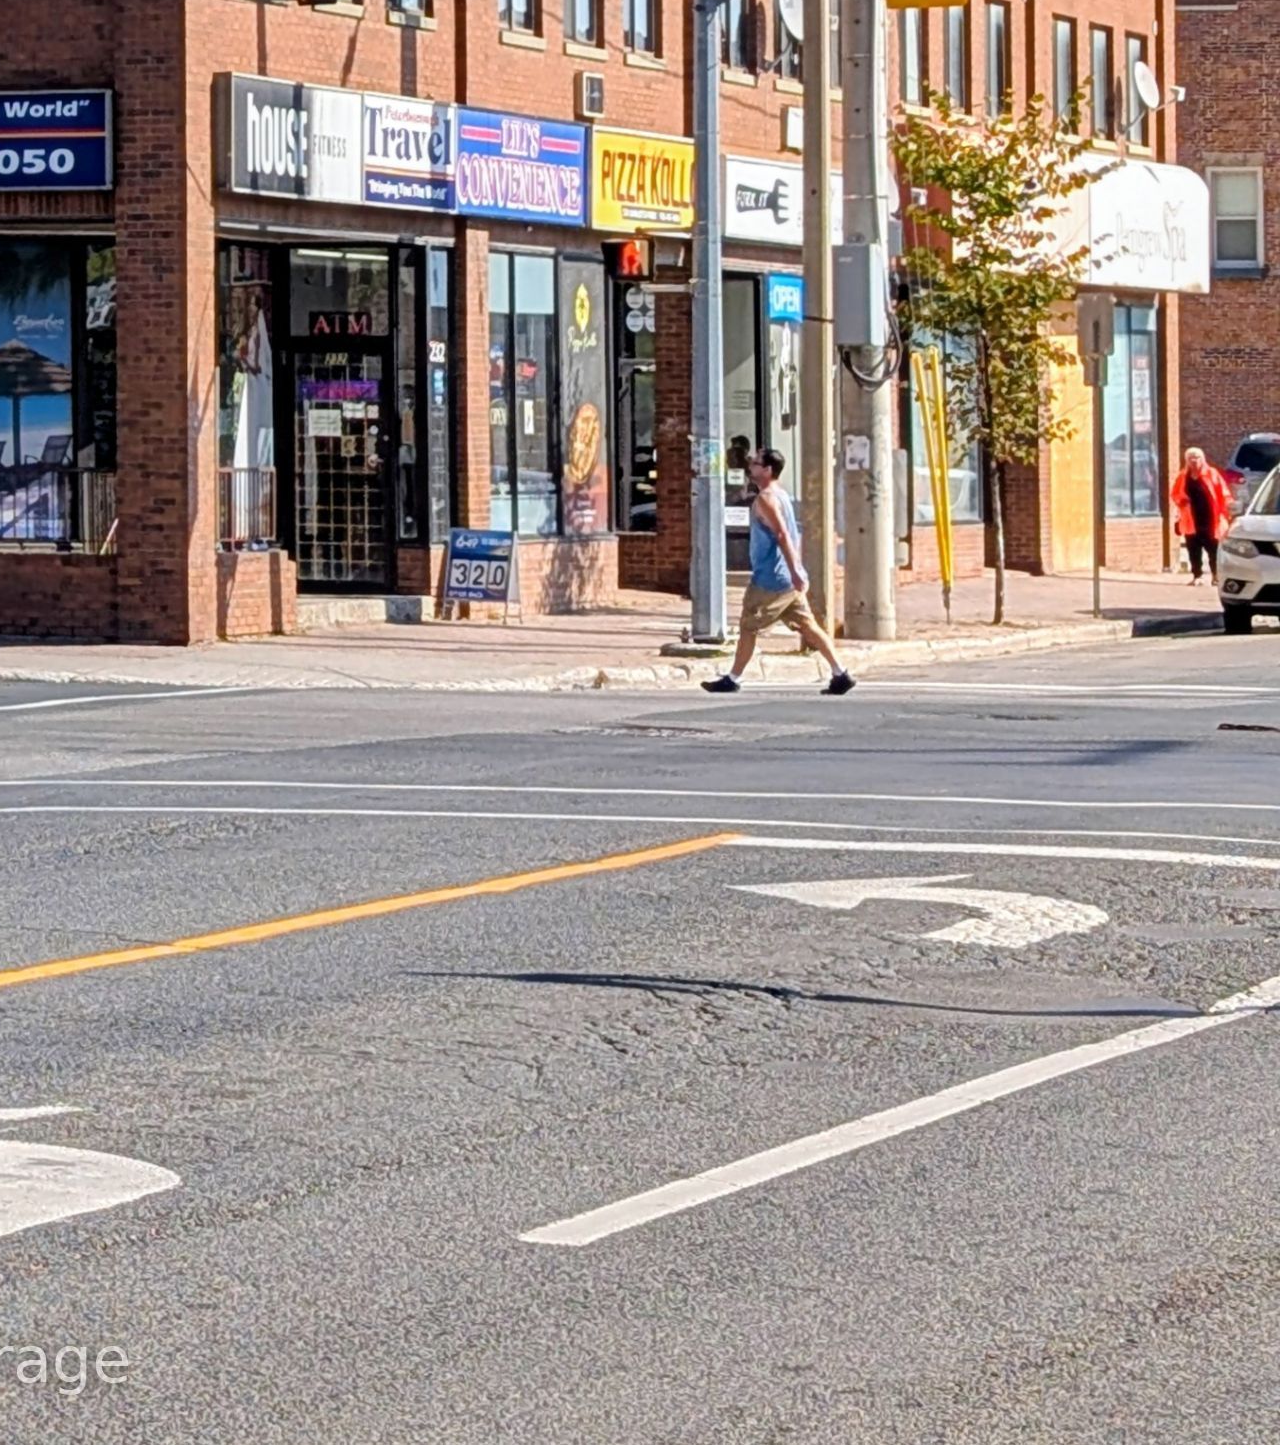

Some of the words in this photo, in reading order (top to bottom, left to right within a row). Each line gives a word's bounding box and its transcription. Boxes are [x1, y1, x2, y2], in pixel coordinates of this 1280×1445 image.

[364, 104, 452, 166] Travel
[456, 152, 580, 216] CONVENIENCE
[602, 149, 647, 205] PIZZA
[313, 314, 369, 334] ATM
[773, 284, 801, 313] OPEN
